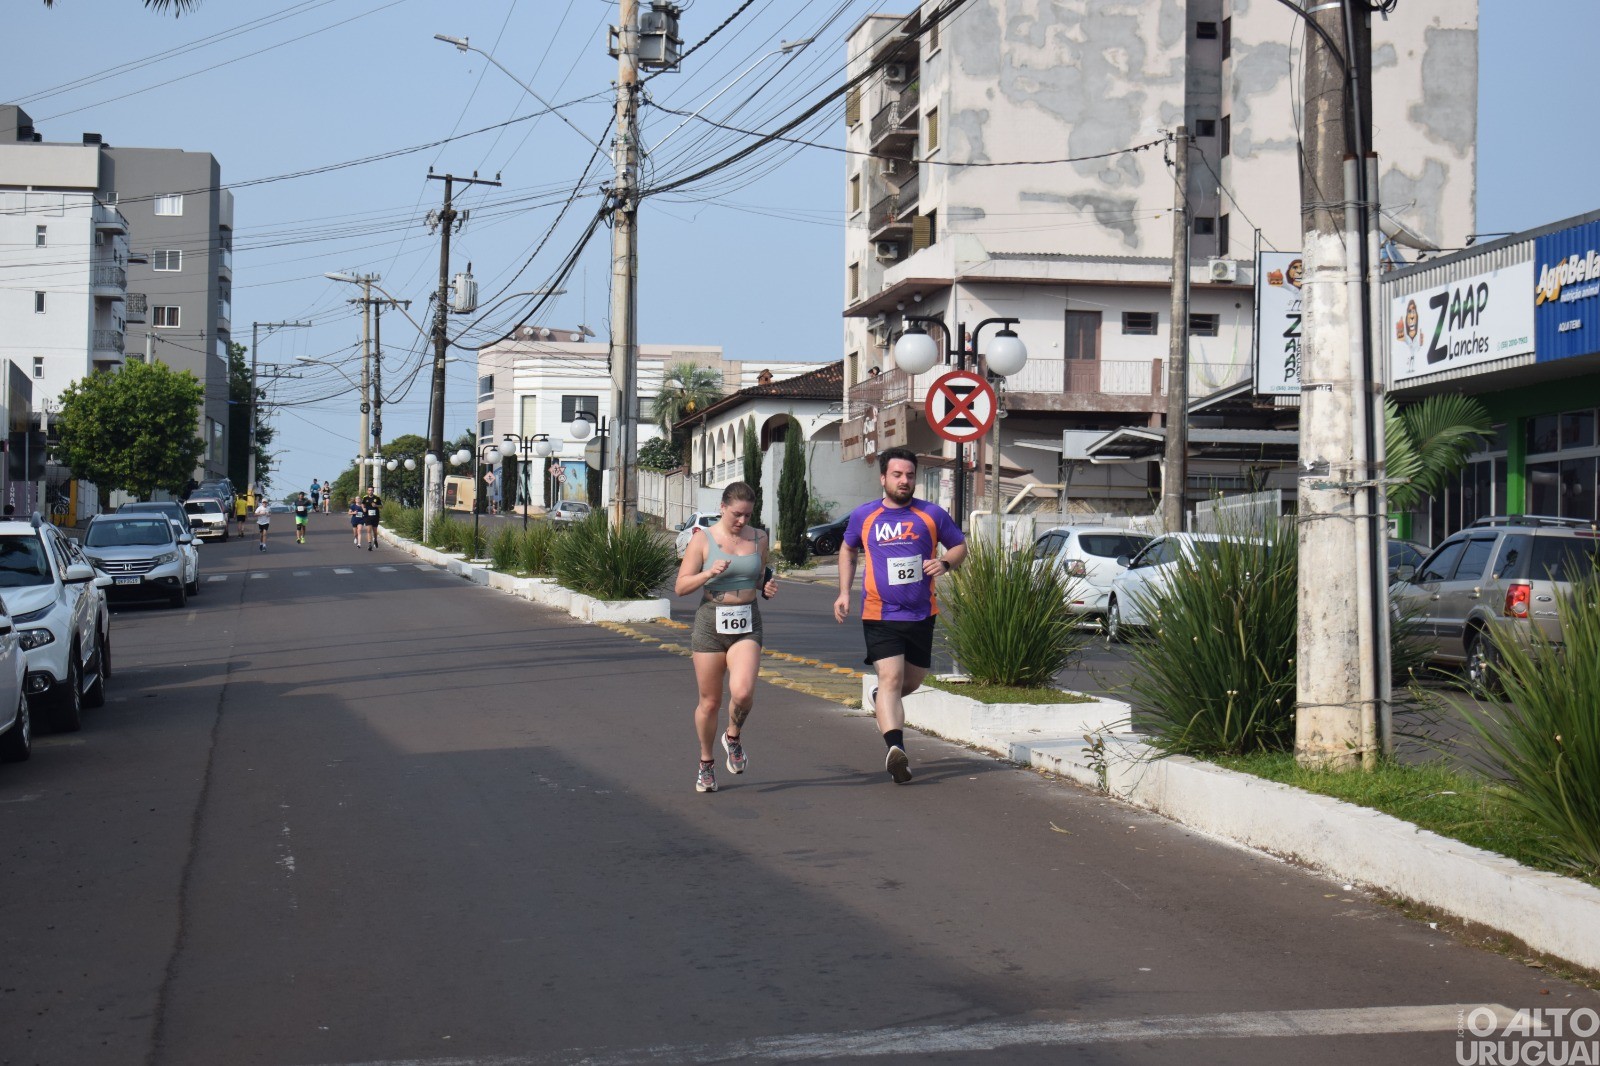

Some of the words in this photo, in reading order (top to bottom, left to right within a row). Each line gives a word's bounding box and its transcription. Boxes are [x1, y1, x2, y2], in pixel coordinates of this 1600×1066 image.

[1537, 250, 1600, 298] AgroBella
[1427, 282, 1489, 365] ZAAP
[1448, 331, 1489, 361] Lanches
[898, 568, 915, 580] 82
[721, 617, 747, 630] 160
